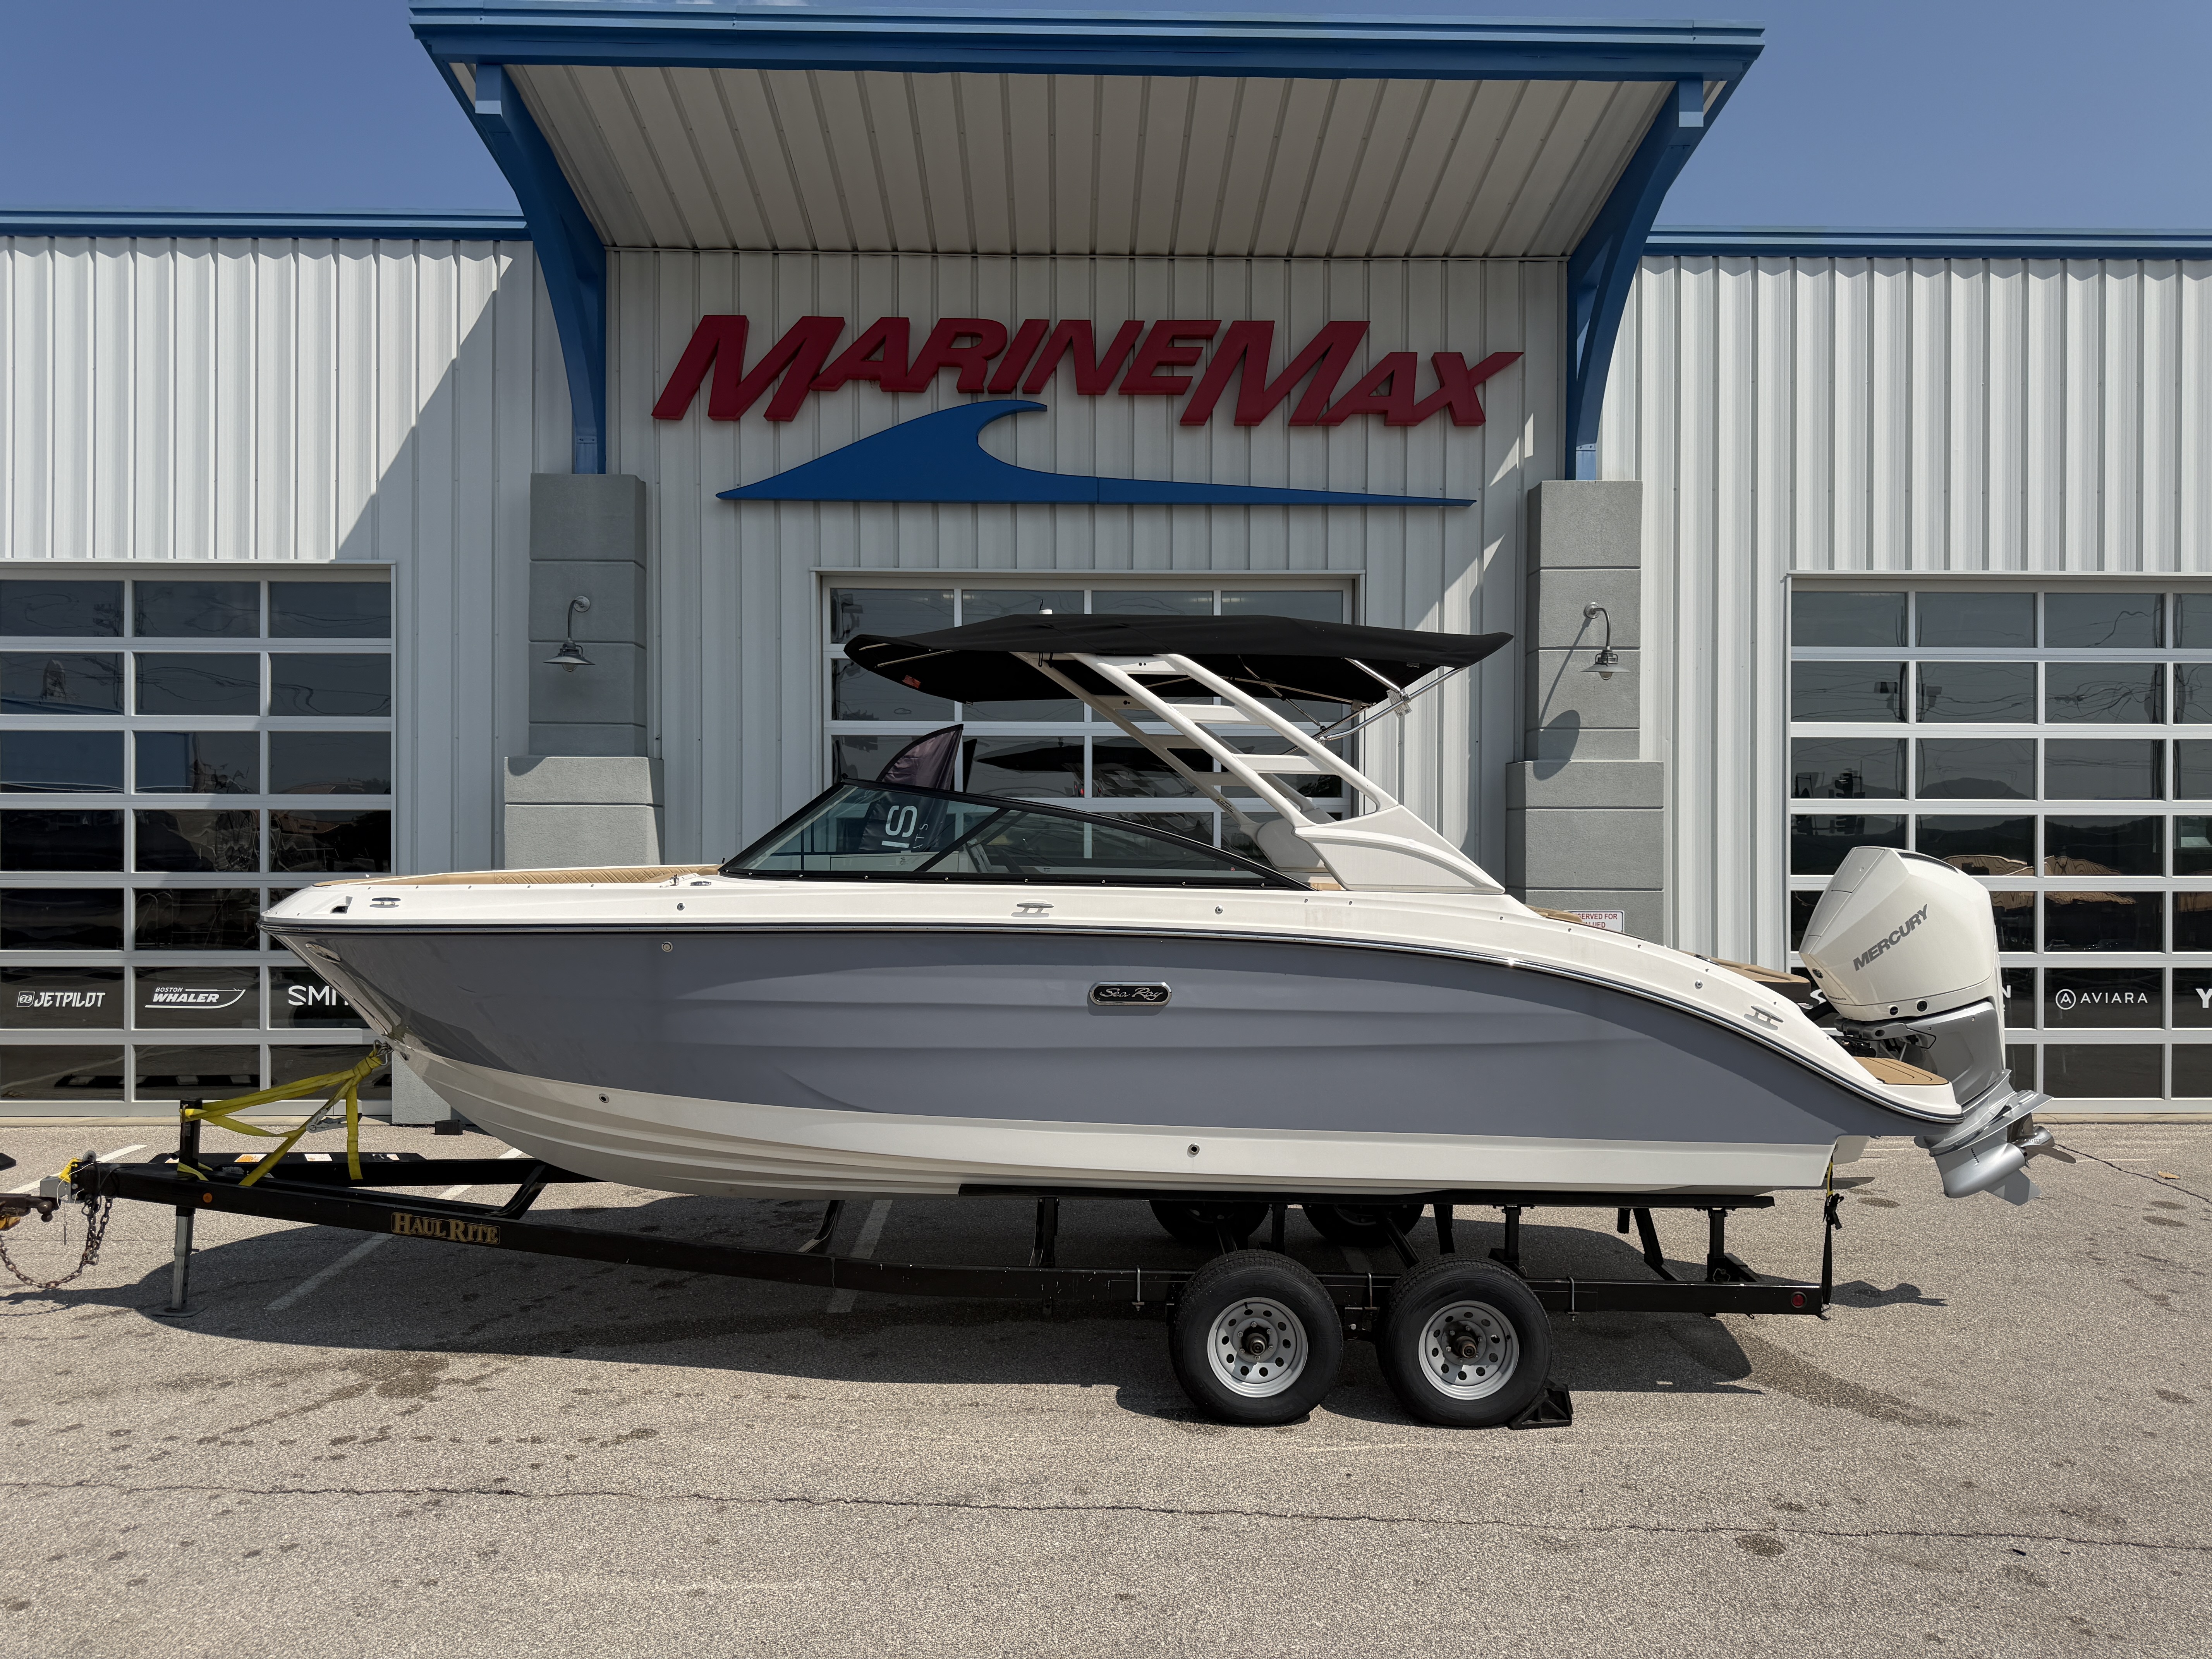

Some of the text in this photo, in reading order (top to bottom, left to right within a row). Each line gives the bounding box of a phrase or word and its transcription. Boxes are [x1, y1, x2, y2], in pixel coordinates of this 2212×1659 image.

[1853, 903, 1927, 971] MERCURY
[34, 992, 106, 1007] JETPILOT
[153, 993, 220, 1003] WHALER
[288, 985, 349, 1006] SMI
[1099, 988, 1163, 1001] Sea Ray
[2080, 992, 2148, 1004] AVIARA
[393, 1212, 499, 1243] HAUL RITE
